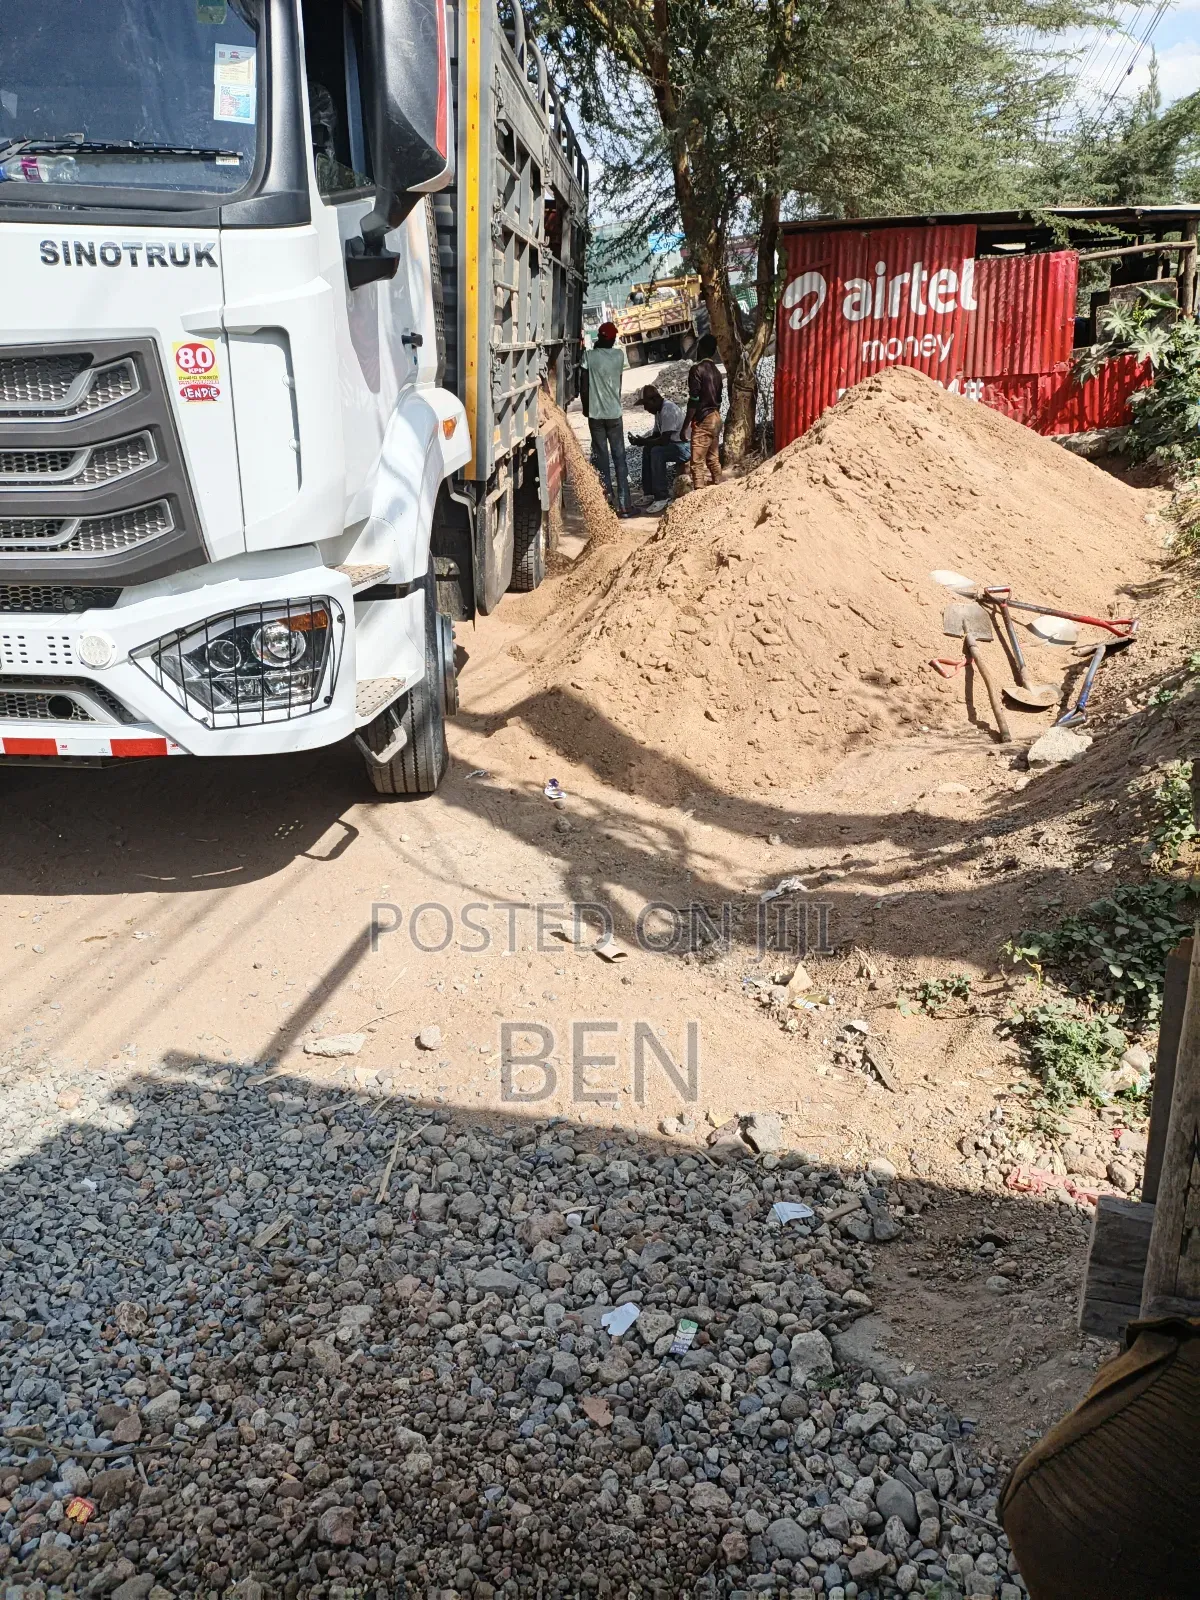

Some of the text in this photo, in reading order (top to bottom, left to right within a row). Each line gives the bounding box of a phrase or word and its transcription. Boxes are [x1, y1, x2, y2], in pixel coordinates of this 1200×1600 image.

[39, 239, 219, 268] SINOTRUK
[842, 257, 979, 322] airtel
[178, 347, 213, 368] 80
[861, 332, 955, 363] money
